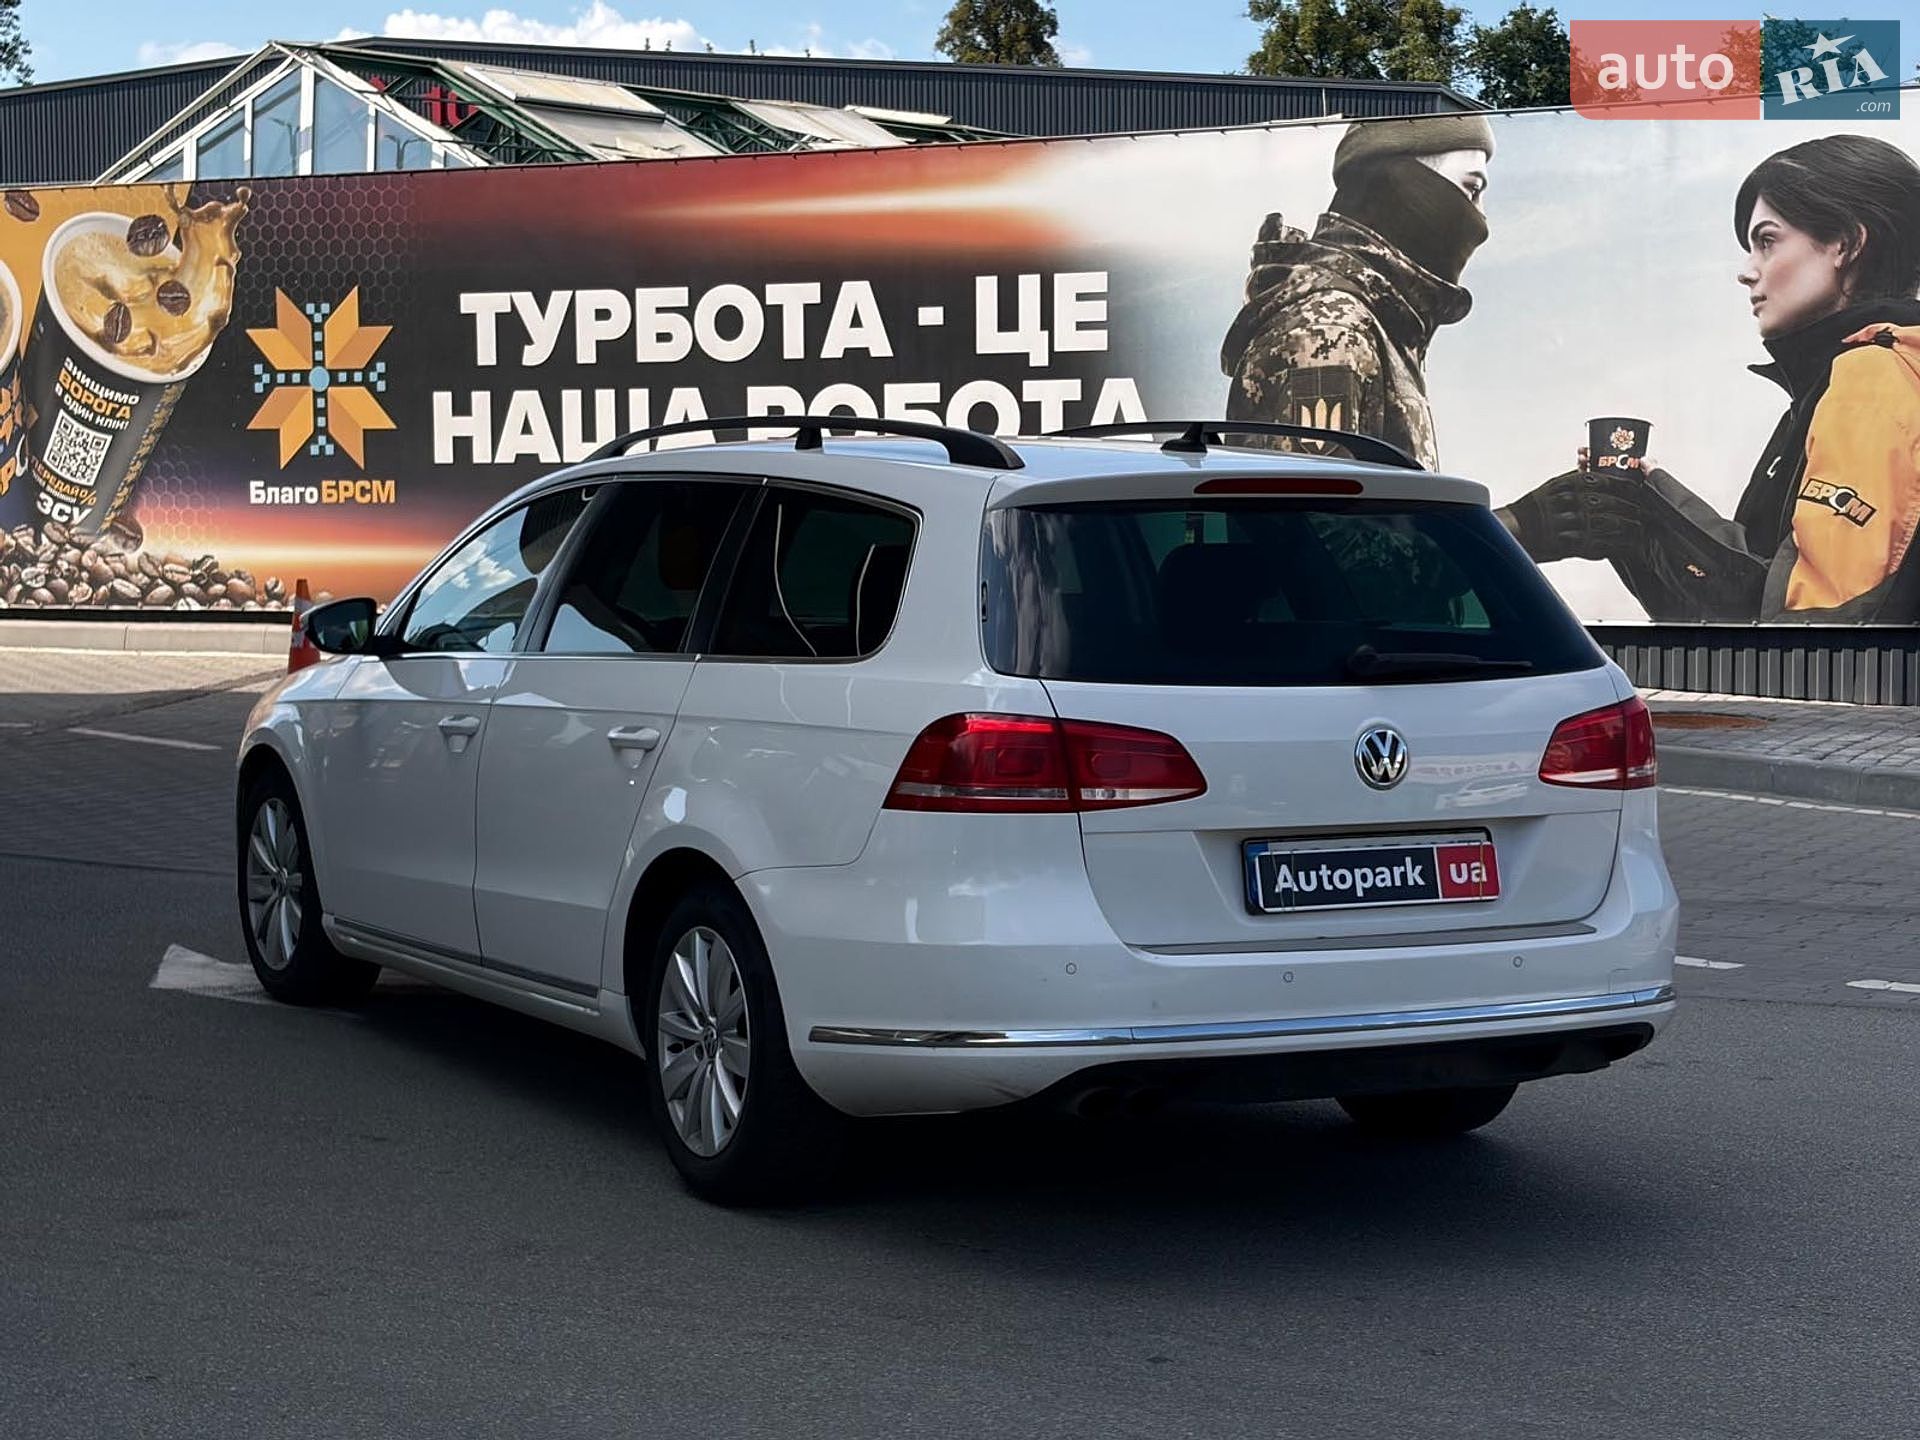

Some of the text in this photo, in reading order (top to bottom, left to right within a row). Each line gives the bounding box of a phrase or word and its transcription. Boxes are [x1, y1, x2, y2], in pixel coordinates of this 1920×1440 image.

[459, 271, 1109, 368] ТУРБОТА - ЦЕ
[59, 367, 131, 419] ВОРОГА
[64, 357, 139, 405] ЗНИЩИМО
[432, 386, 716, 464] НАША
[37, 491, 93, 525] ЗСУ
[1804, 480, 1873, 522] БРСМ
[1274, 856, 1488, 898] Autopark ua
